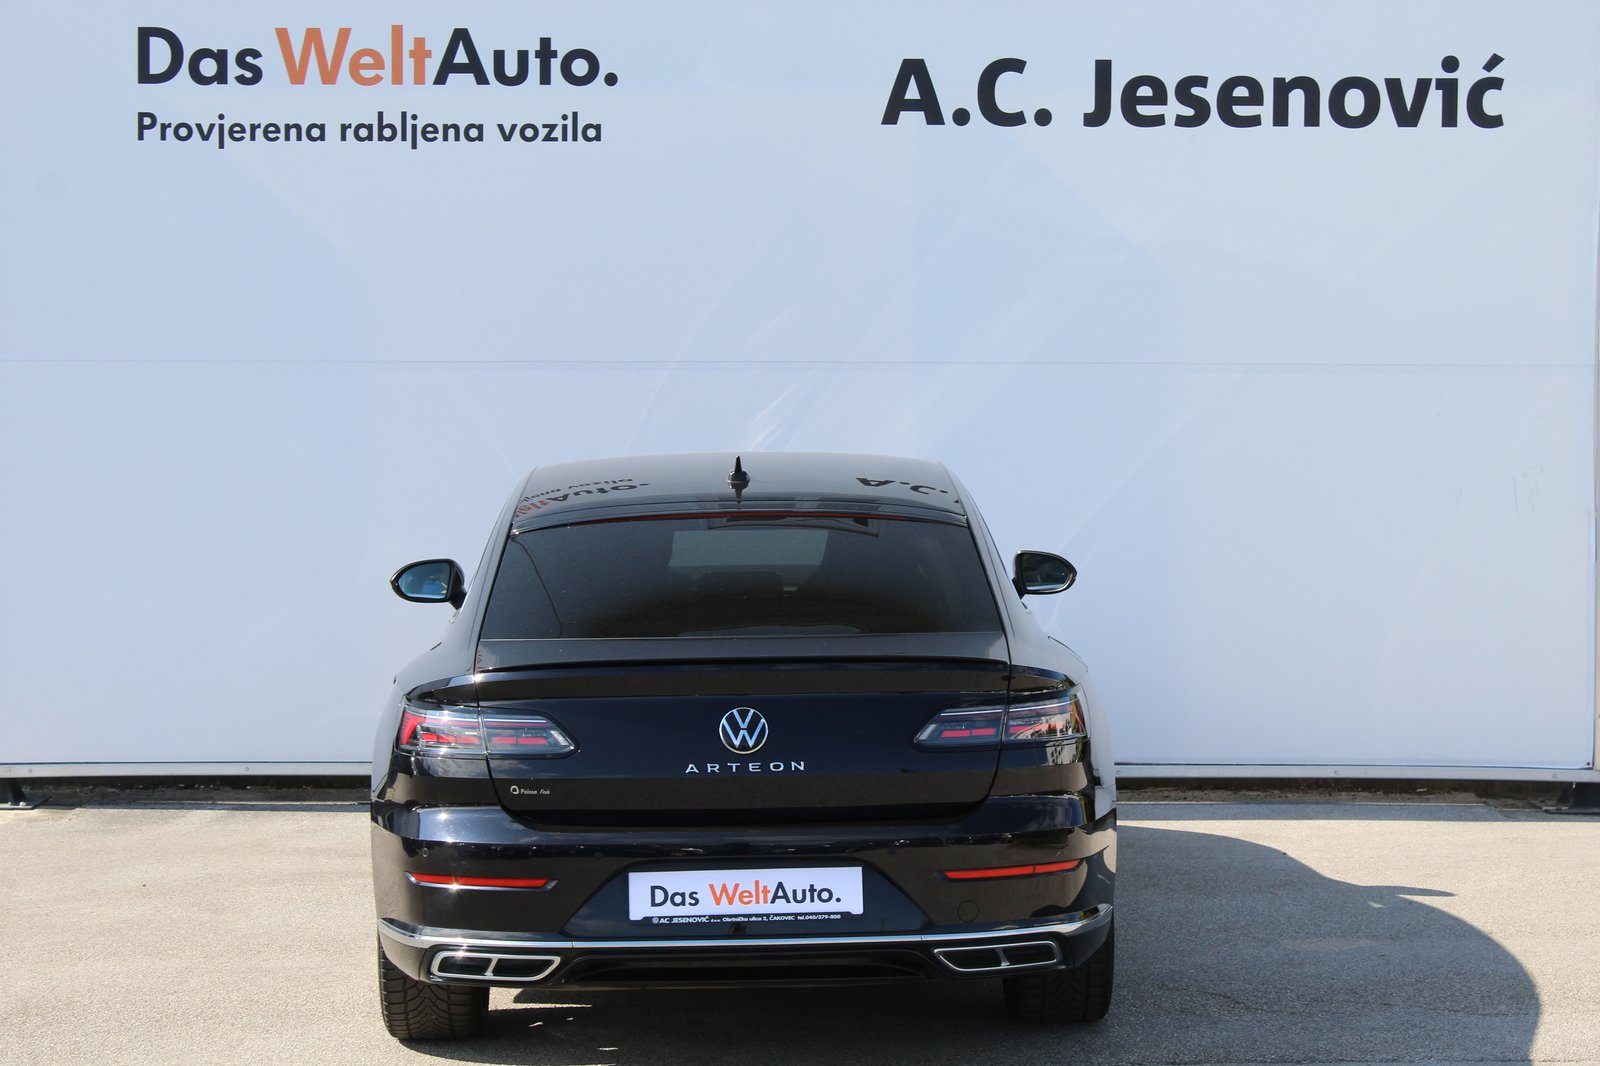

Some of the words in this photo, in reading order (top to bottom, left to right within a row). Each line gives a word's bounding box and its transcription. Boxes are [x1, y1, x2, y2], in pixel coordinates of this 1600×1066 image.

[137, 26, 264, 86] Das
[274, 24, 619, 87] WeltAuto.
[881, 57, 1053, 128] A.C.
[1083, 53, 1505, 129] Jesenović
[137, 111, 327, 150] Provjerena
[340, 111, 485, 150] rabljena
[497, 111, 603, 143] vozila
[719, 706, 769, 755] VW
[685, 761, 806, 774] ARTEON
[650, 885, 700, 908] Das
[708, 879, 842, 907] WeltAuto.
